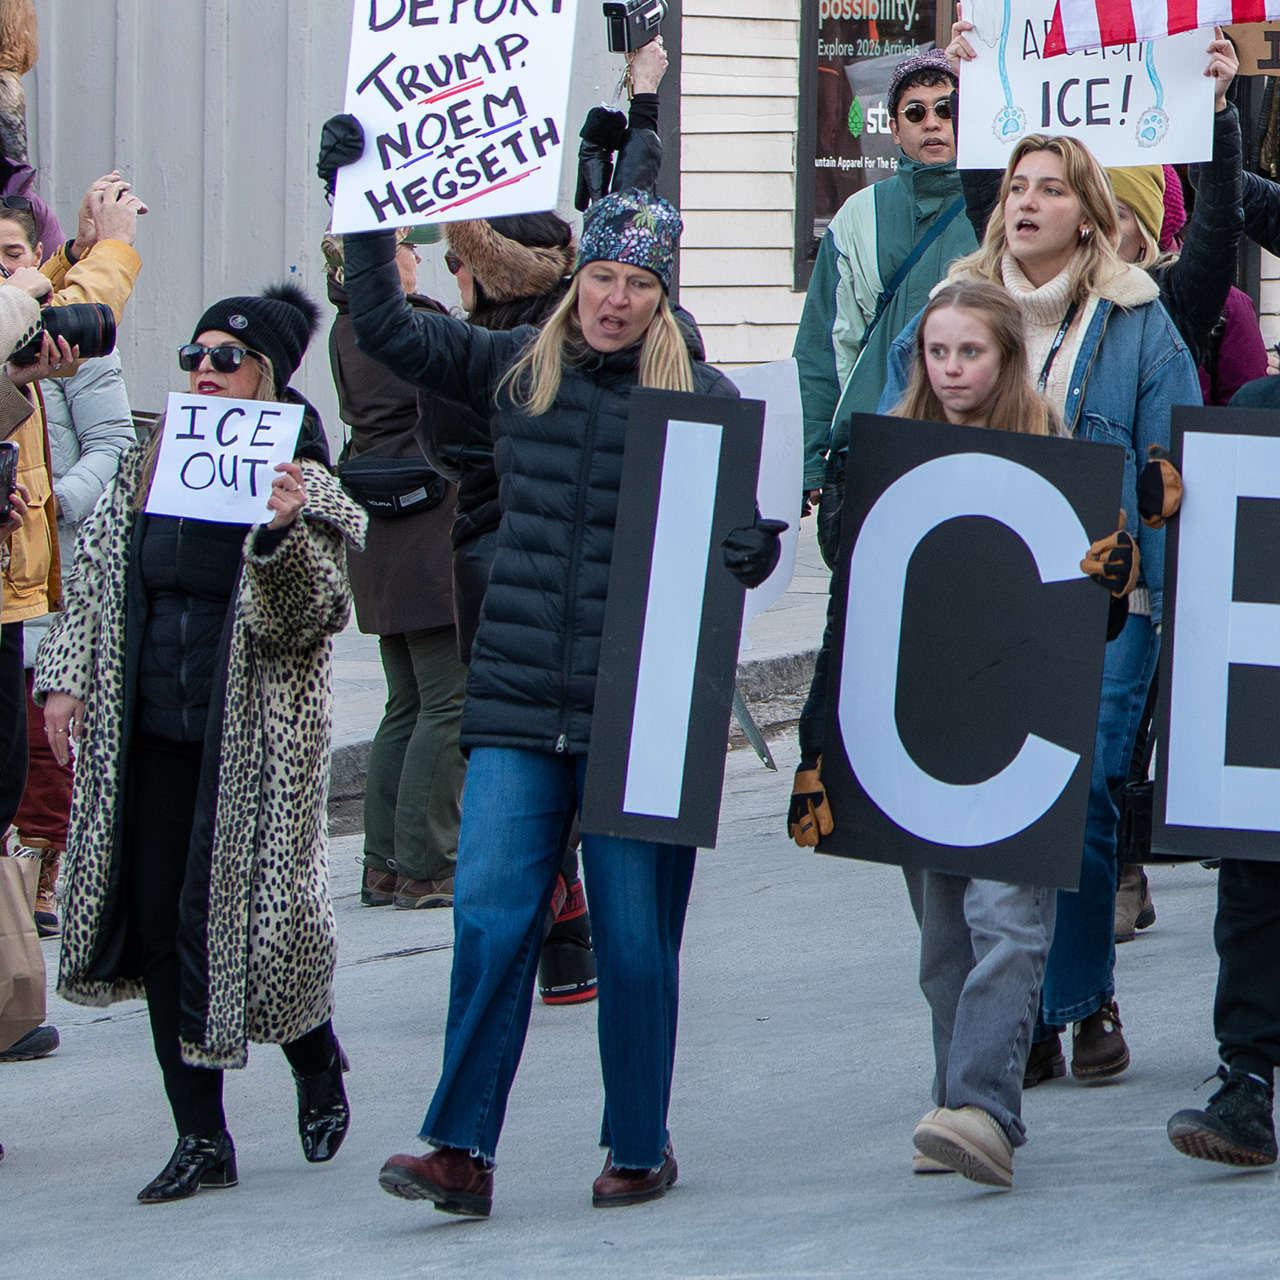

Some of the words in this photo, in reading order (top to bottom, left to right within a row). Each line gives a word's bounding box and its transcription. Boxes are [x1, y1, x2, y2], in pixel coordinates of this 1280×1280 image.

[817, 38, 854, 61] Explore
[856, 38, 881, 57] 2026
[883, 39, 920, 57] Arrivals
[1041, 74, 1132, 128] ICE!
[376, 85, 527, 170] NOEM
[364, 117, 560, 223] HEGSETH
[837, 156, 863, 171] Apparel
[864, 157, 876, 169] For
[877, 157, 889, 169] The
[176, 405, 282, 448] ICE
[180, 451, 269, 498] OUT
